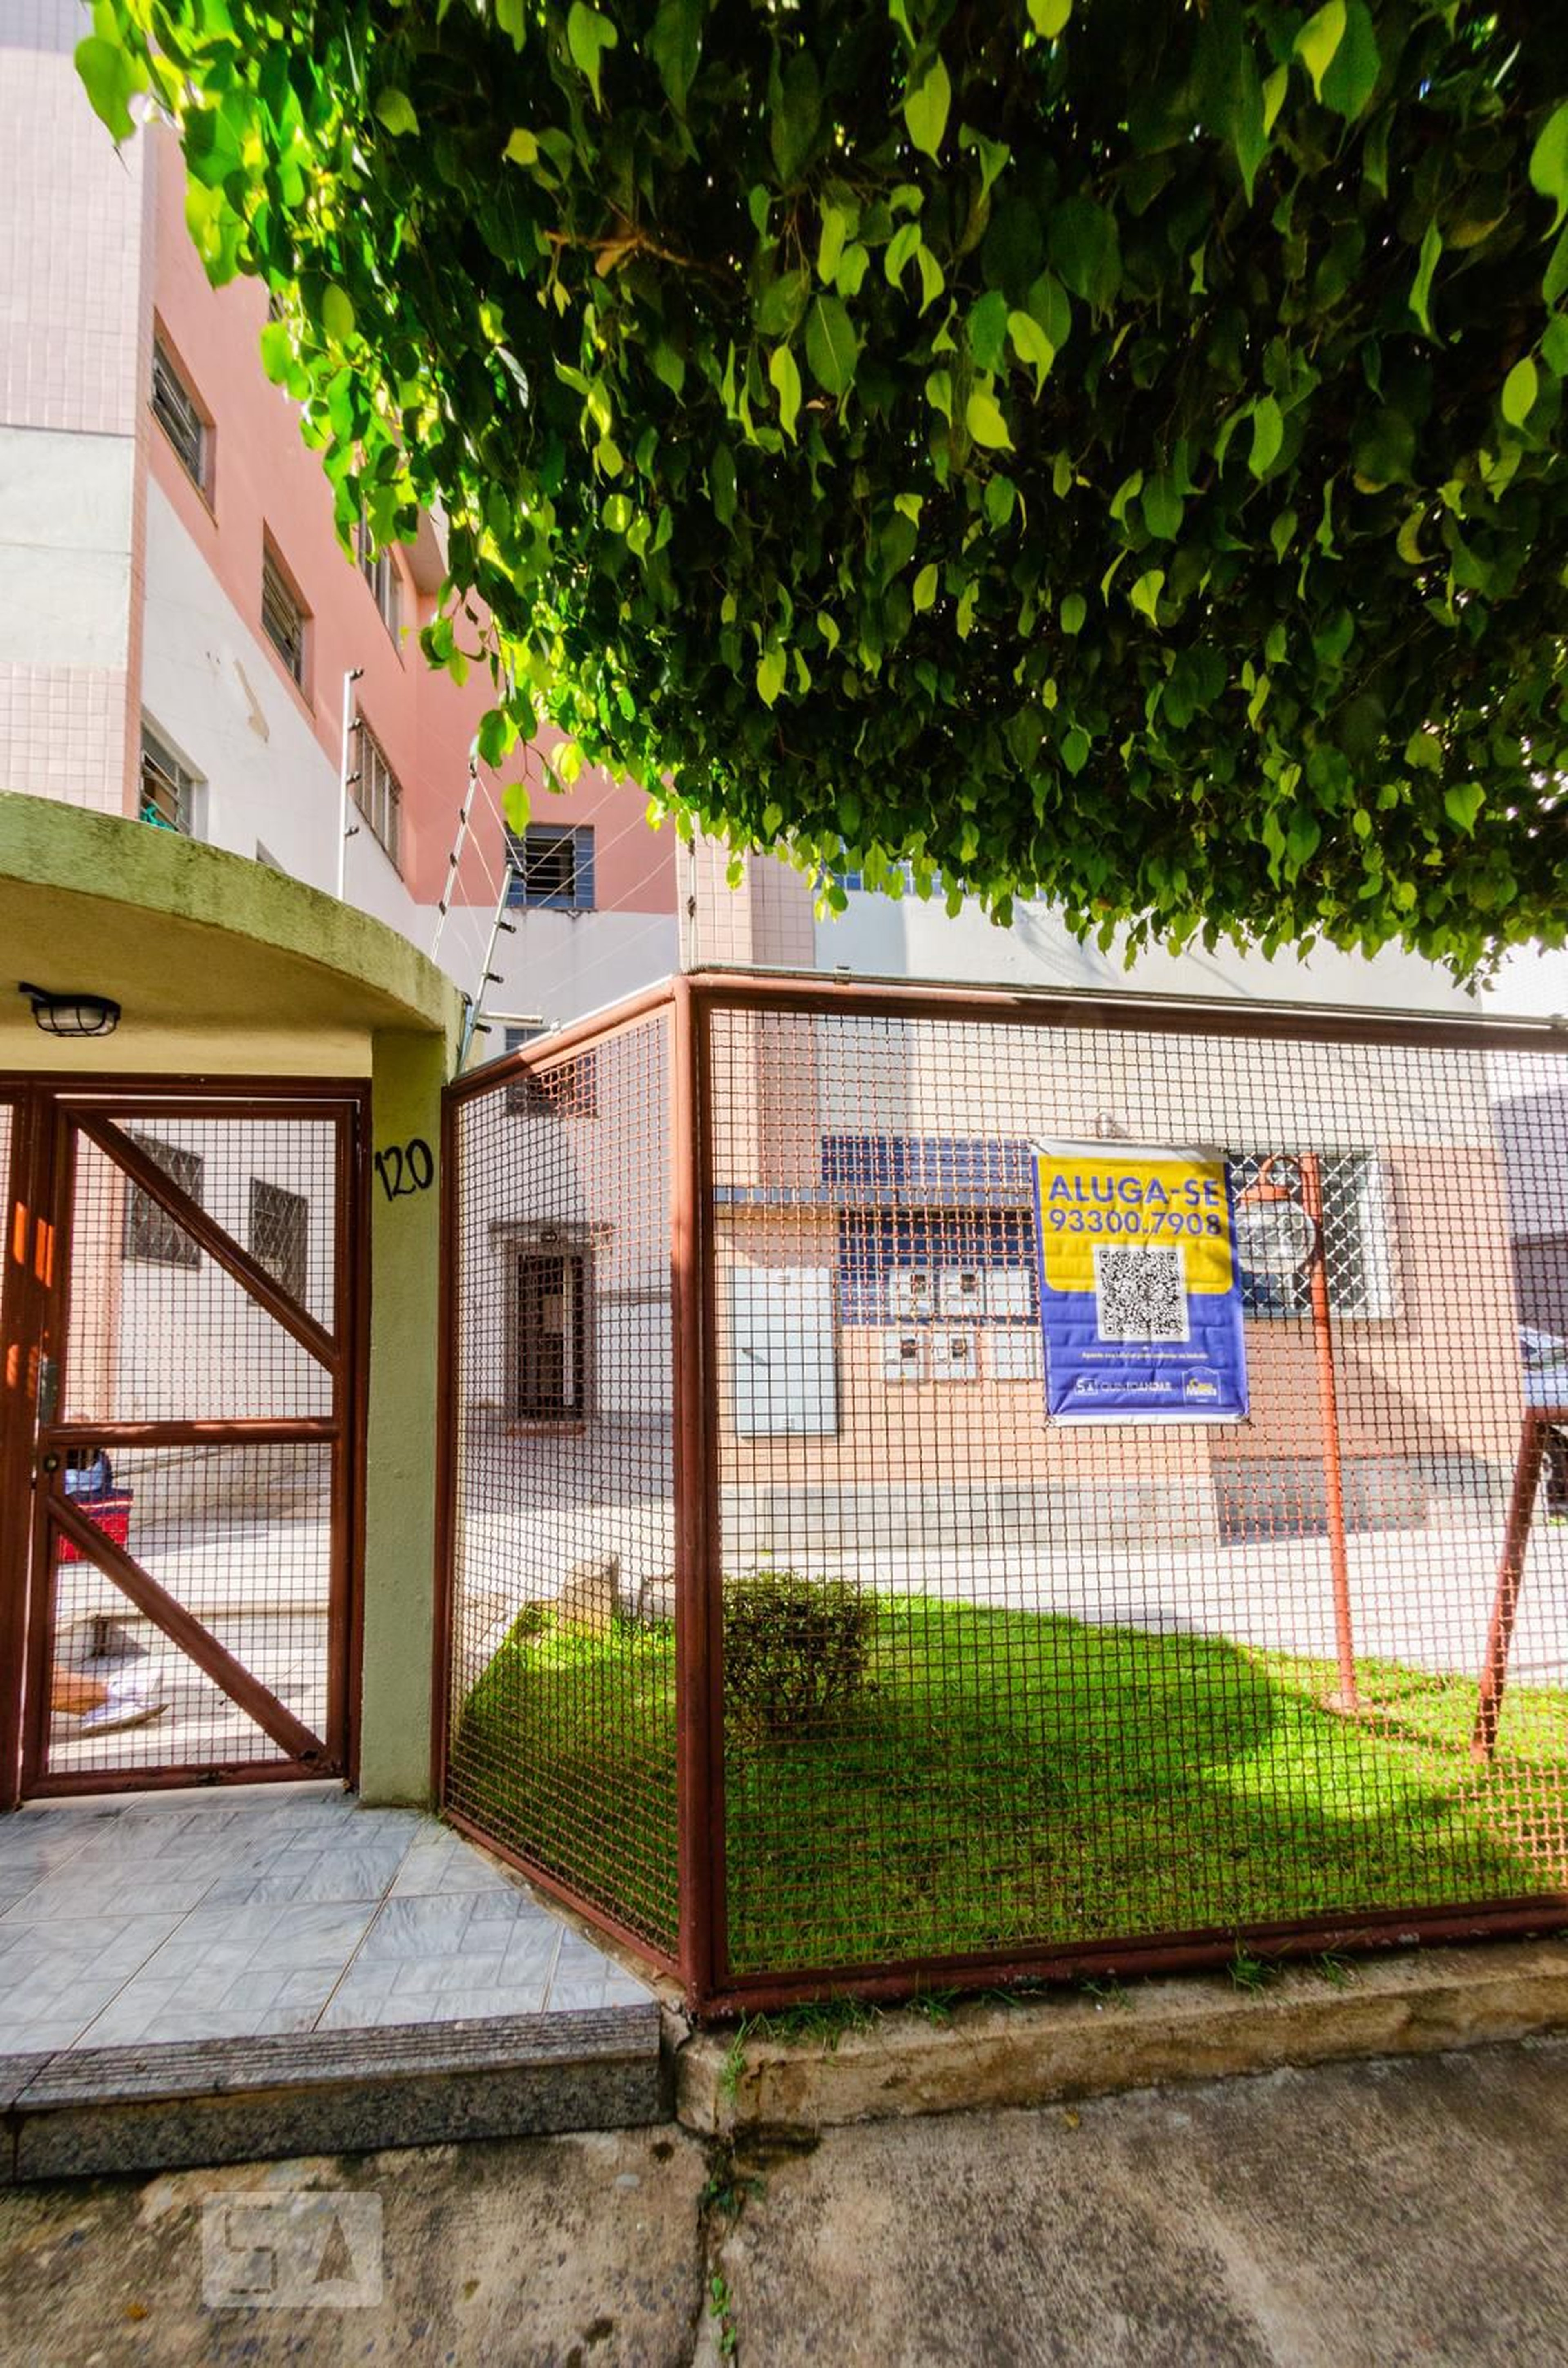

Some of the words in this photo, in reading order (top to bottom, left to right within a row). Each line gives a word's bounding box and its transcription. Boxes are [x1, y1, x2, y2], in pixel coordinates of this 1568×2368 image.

[375, 1139, 433, 1201] 120
[1049, 1175, 1219, 1206] ALUGA-SE
[1049, 1209, 1221, 1235] 93300.7908
